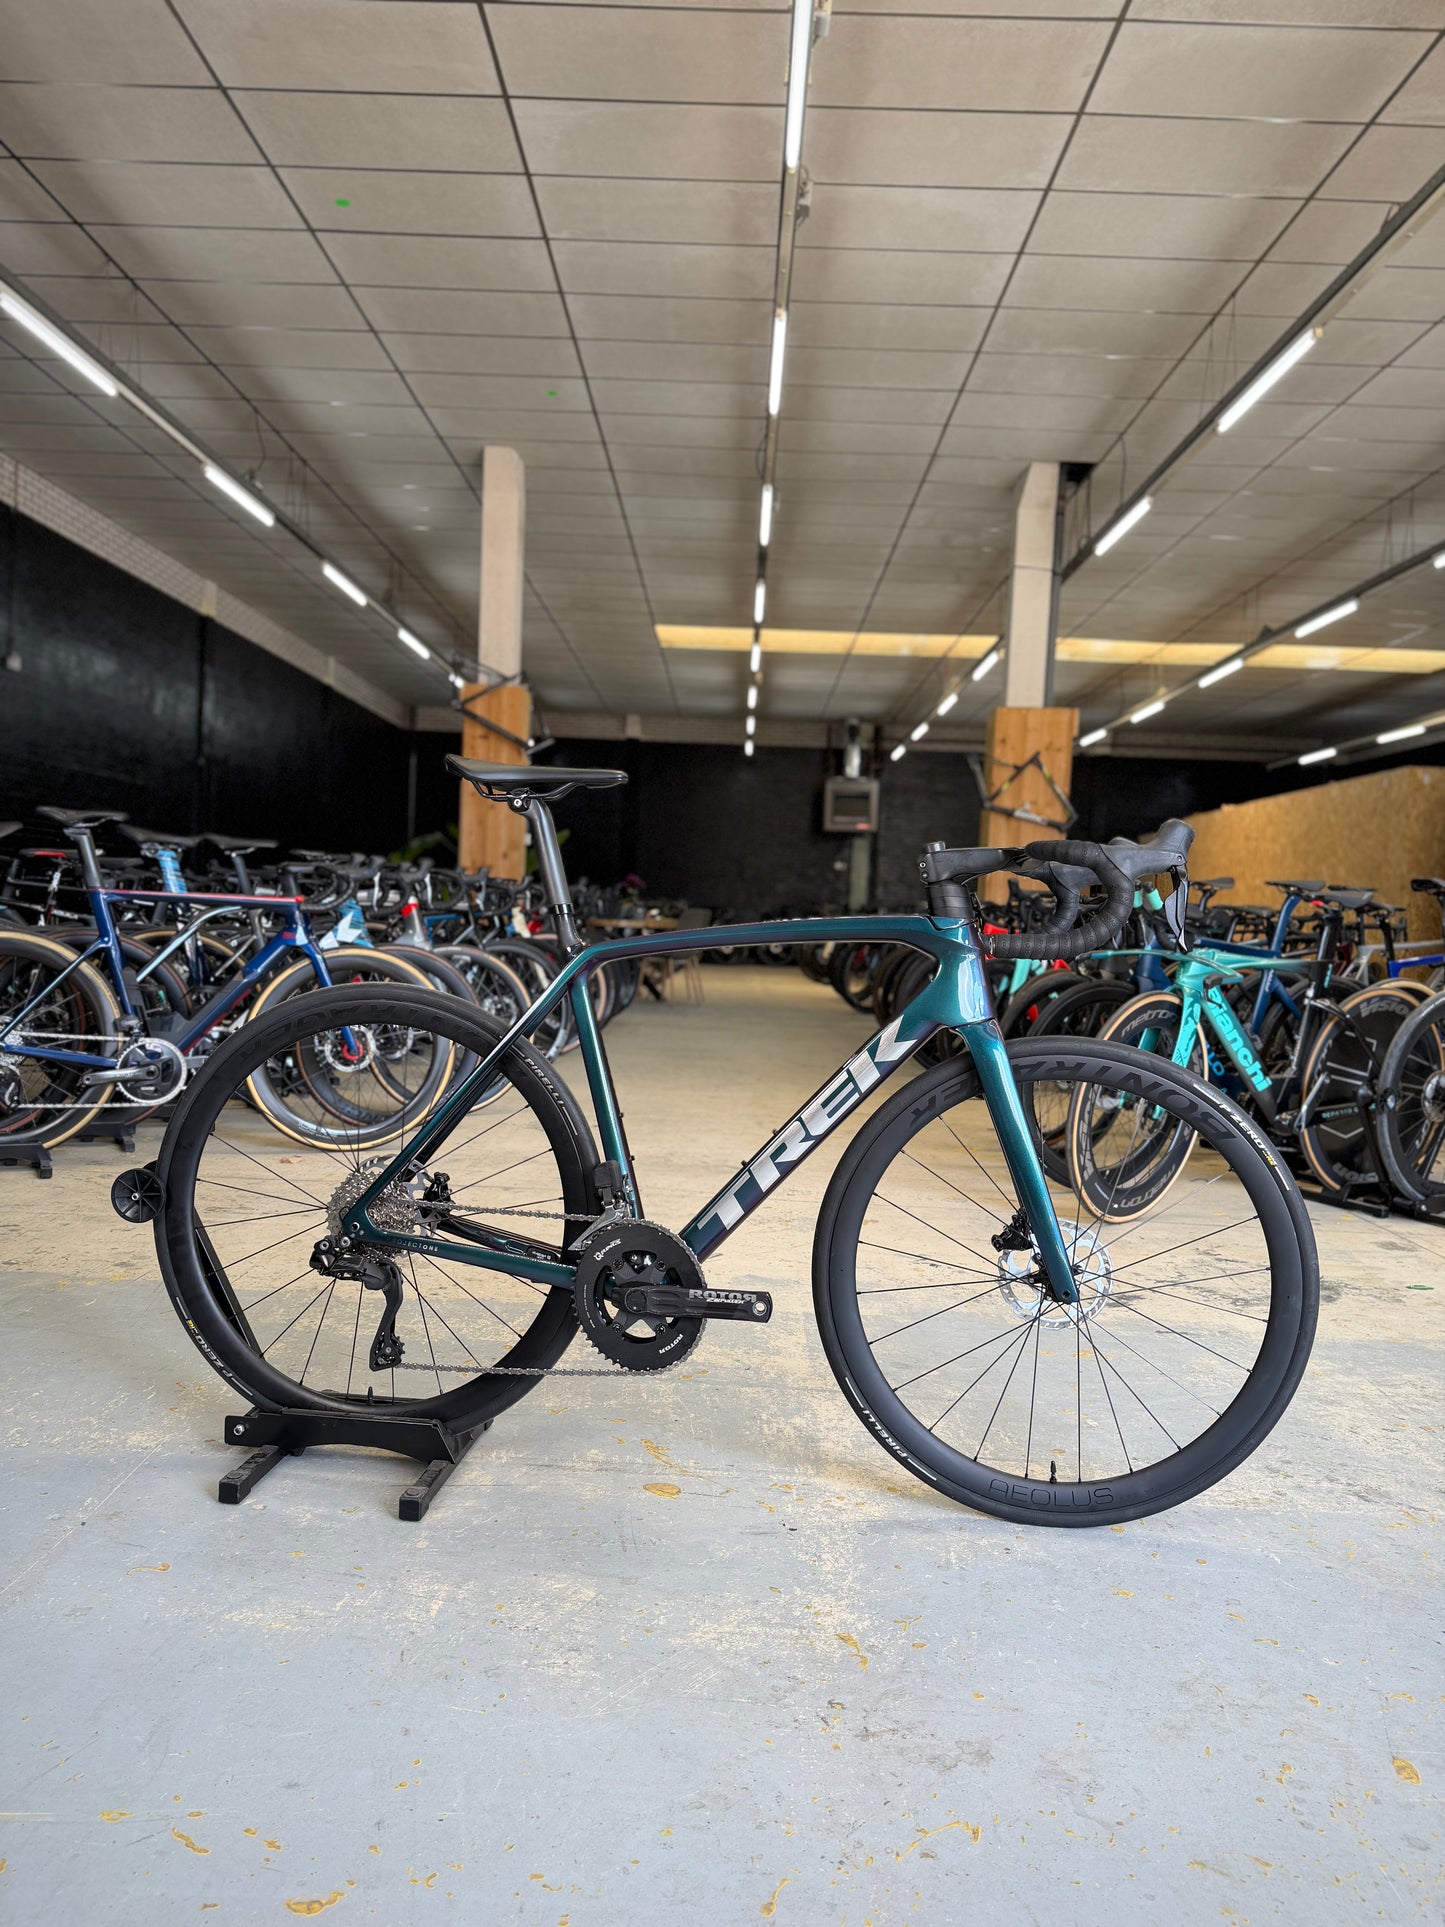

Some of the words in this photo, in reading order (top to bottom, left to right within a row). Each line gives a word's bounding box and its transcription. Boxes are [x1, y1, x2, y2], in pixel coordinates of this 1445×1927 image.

[1207, 985, 1272, 1092] Bianchi
[524, 1057, 565, 1106] PIRELLI
[910, 1058, 1237, 1142] BONTRAER
[697, 1014, 918, 1231] TREK
[689, 1289, 757, 1303] ROTOR
[658, 1333, 684, 1355] ROTOR
[861, 1410, 908, 1458] PIRELLI
[989, 1477, 1114, 1507] AEOLUS
